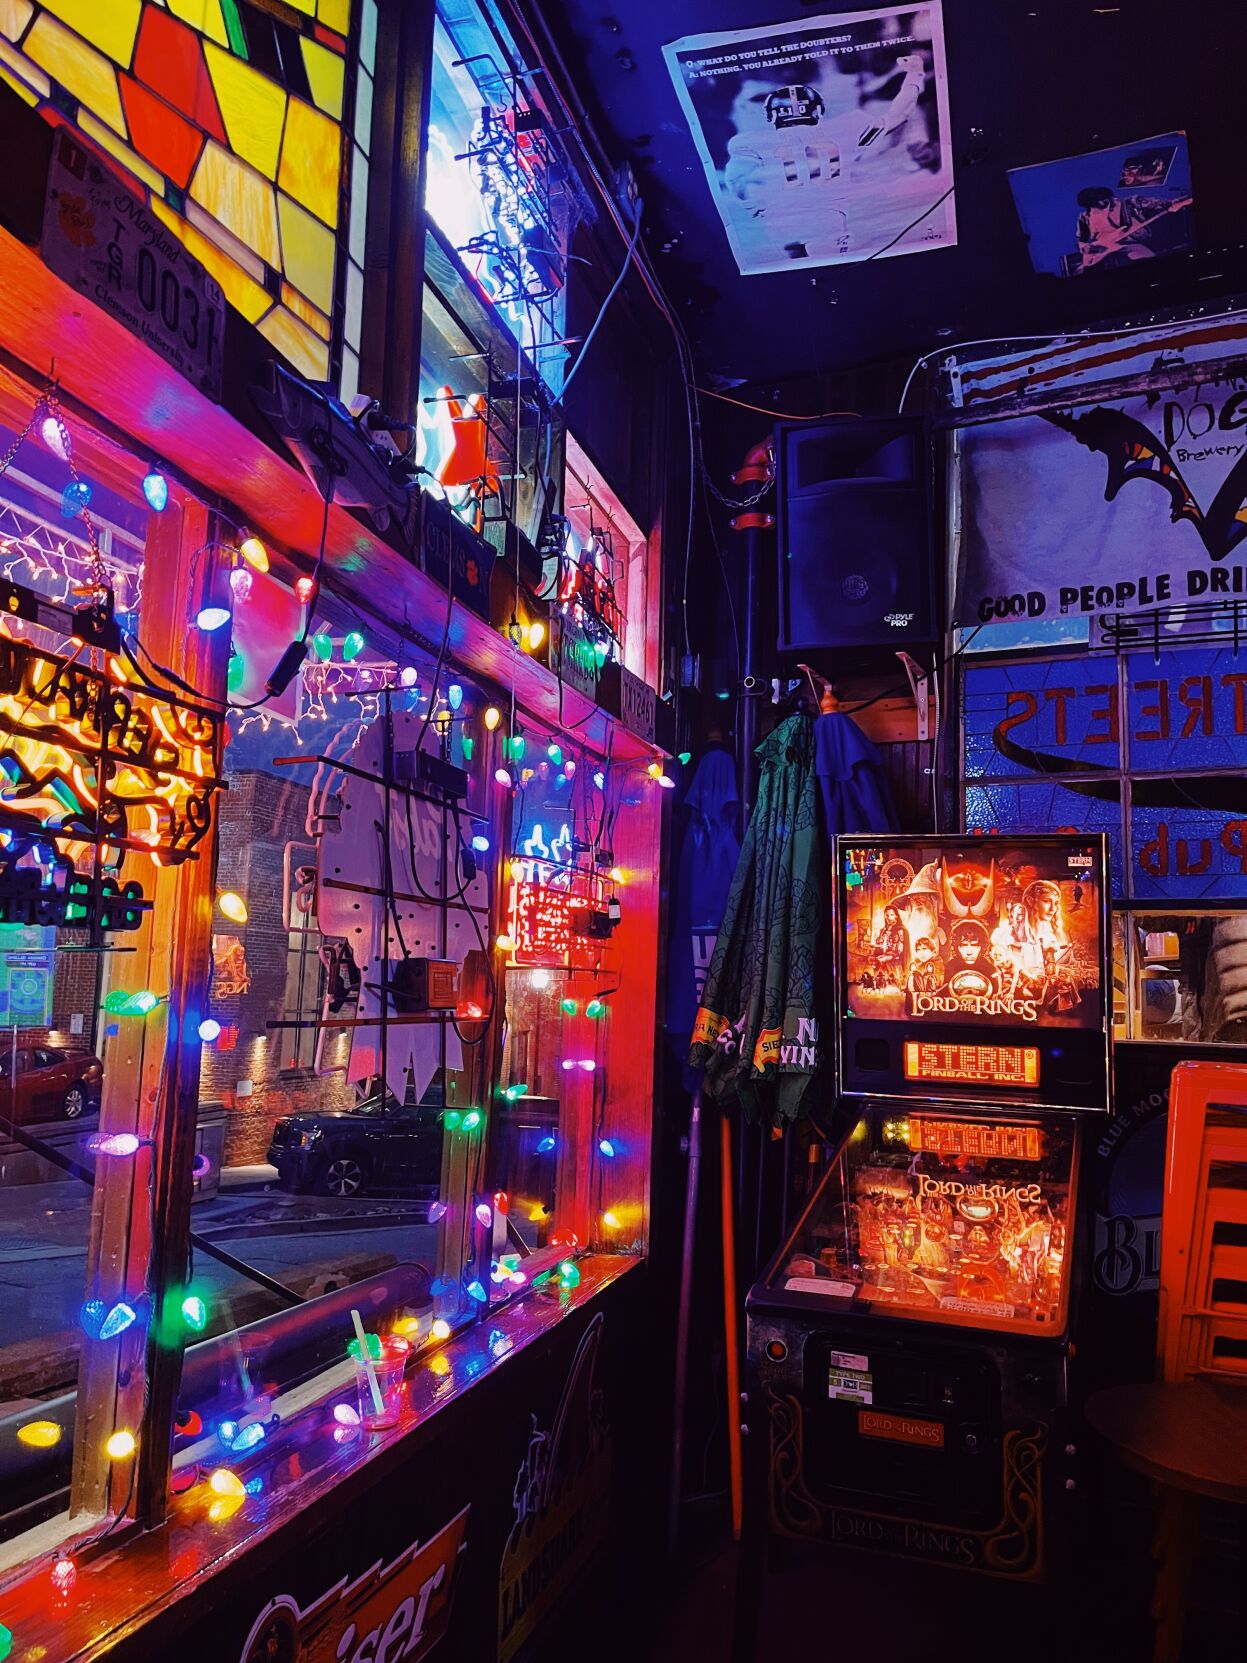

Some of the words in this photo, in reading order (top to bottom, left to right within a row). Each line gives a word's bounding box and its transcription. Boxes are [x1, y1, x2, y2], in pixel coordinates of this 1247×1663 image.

[697, 57, 724, 66] WHAT
[724, 54, 738, 62] DO
[738, 51, 757, 59] YOU
[757, 47, 781, 57] TELL
[781, 43, 800, 52] THE
[800, 35, 852, 48] DOUBTERS?
[700, 65, 743, 77] NOTHING.
[742, 61, 761, 70] YOU
[762, 54, 803, 67] ALREADY
[804, 50, 829, 60] TOLD
[840, 45, 854, 53] TO
[854, 41, 880, 51] THEM
[881, 36, 916, 46] TWICE.
[113, 195, 180, 265] Maryland
[94, 284, 140, 329] Clemson
[136, 246, 219, 366] 0031
[140, 320, 185, 367] University
[1175, 444, 1246, 462] Brewery
[977, 591, 1046, 622] GOOD
[1059, 574, 1171, 614] PEOPLE
[1187, 566, 1247, 596] DRI
[890, 619, 908, 627] PRO
[1068, 857, 1092, 867] STERN
[911, 991, 959, 1016] LORD
[960, 1004, 976, 1012] THE
[974, 996, 1038, 1021] RINGS
[921, 1044, 1021, 1073] STERN
[922, 1070, 989, 1080] PINBALL,
[994, 1073, 1025, 1082] INC.
[1096, 1114, 1132, 1158] BLUE
[864, 1414, 892, 1431] LORD
[902, 1422, 940, 1442] RINGS
[831, 1509, 884, 1541] LORD
[903, 1523, 976, 1565] RINGS
